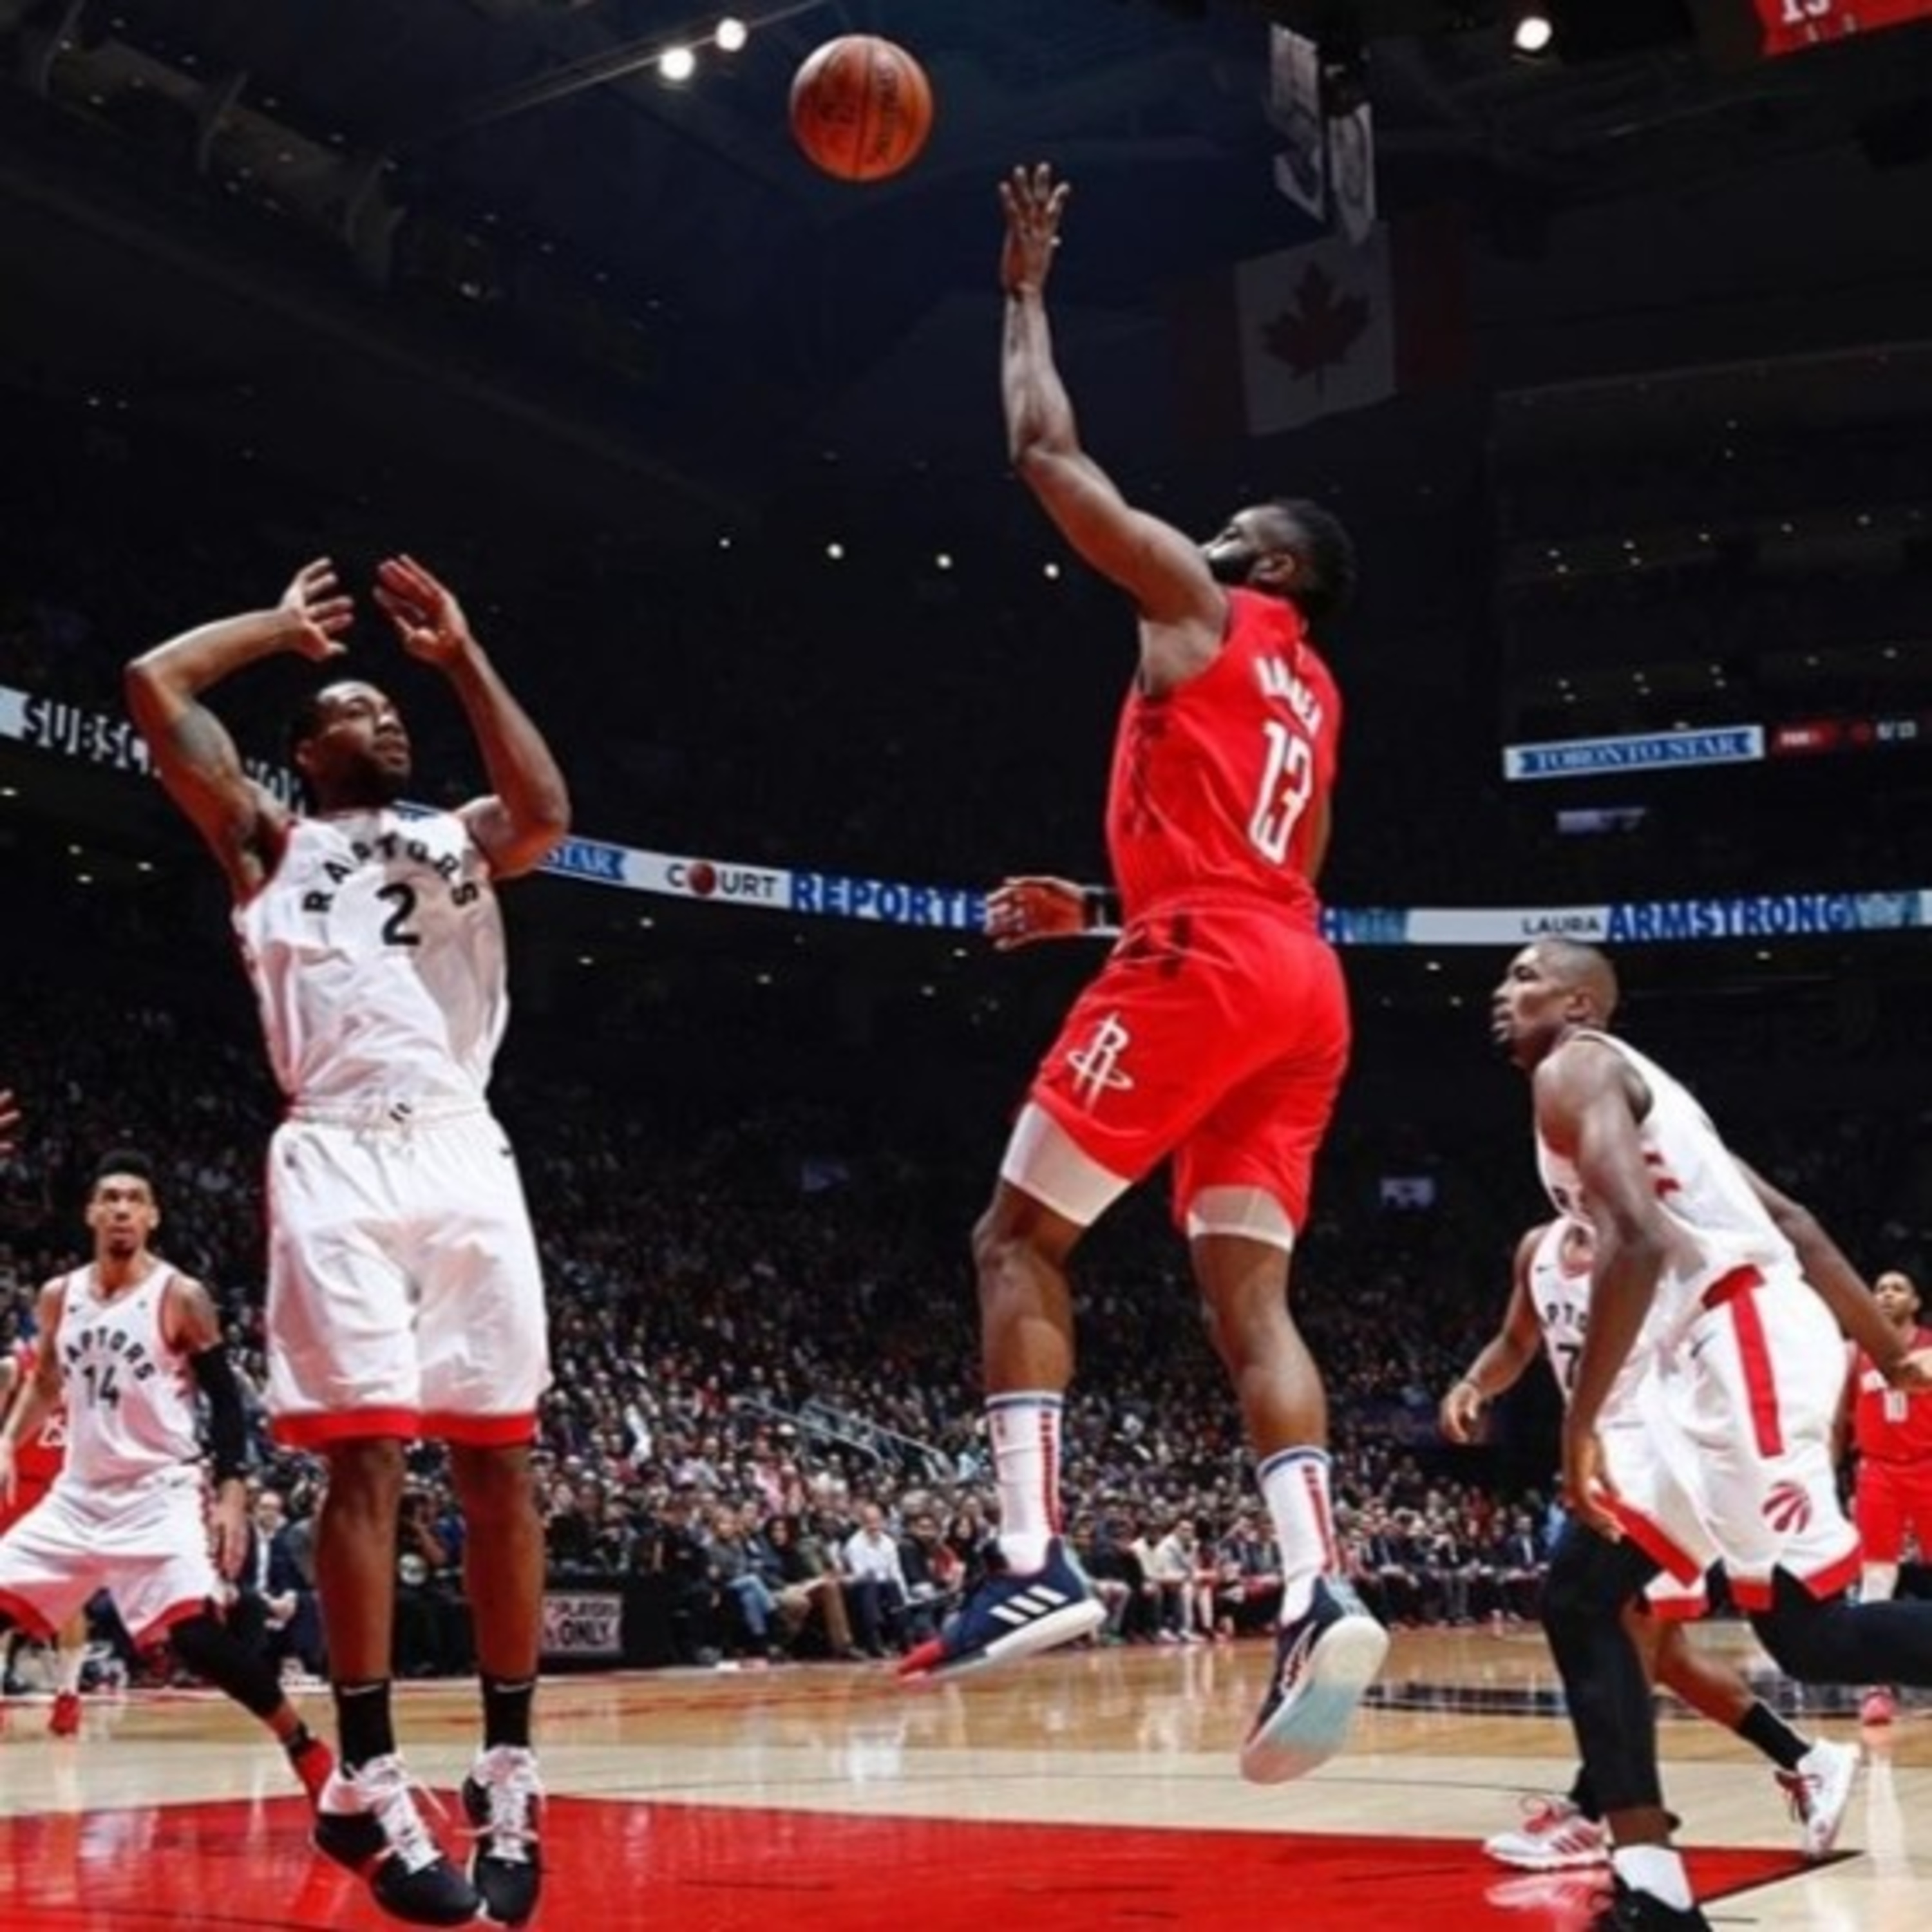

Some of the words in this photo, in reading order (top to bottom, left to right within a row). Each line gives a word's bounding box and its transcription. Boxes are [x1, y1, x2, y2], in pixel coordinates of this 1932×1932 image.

[23, 696, 148, 772] SUBSC
[1535, 736, 1663, 770] TORONTO
[1667, 734, 1736, 759] STAR
[1249, 718, 1313, 863] 13
[301, 831, 478, 913] RAPTORS
[665, 861, 778, 897] COURT
[791, 871, 988, 929] REPORTE
[375, 882, 421, 946] 2
[1522, 914, 1602, 936] LAURA
[1609, 895, 1852, 940] ARMSTRONG
[83, 1363, 120, 1410] 14
[558, 1619, 611, 1647] ONLY
